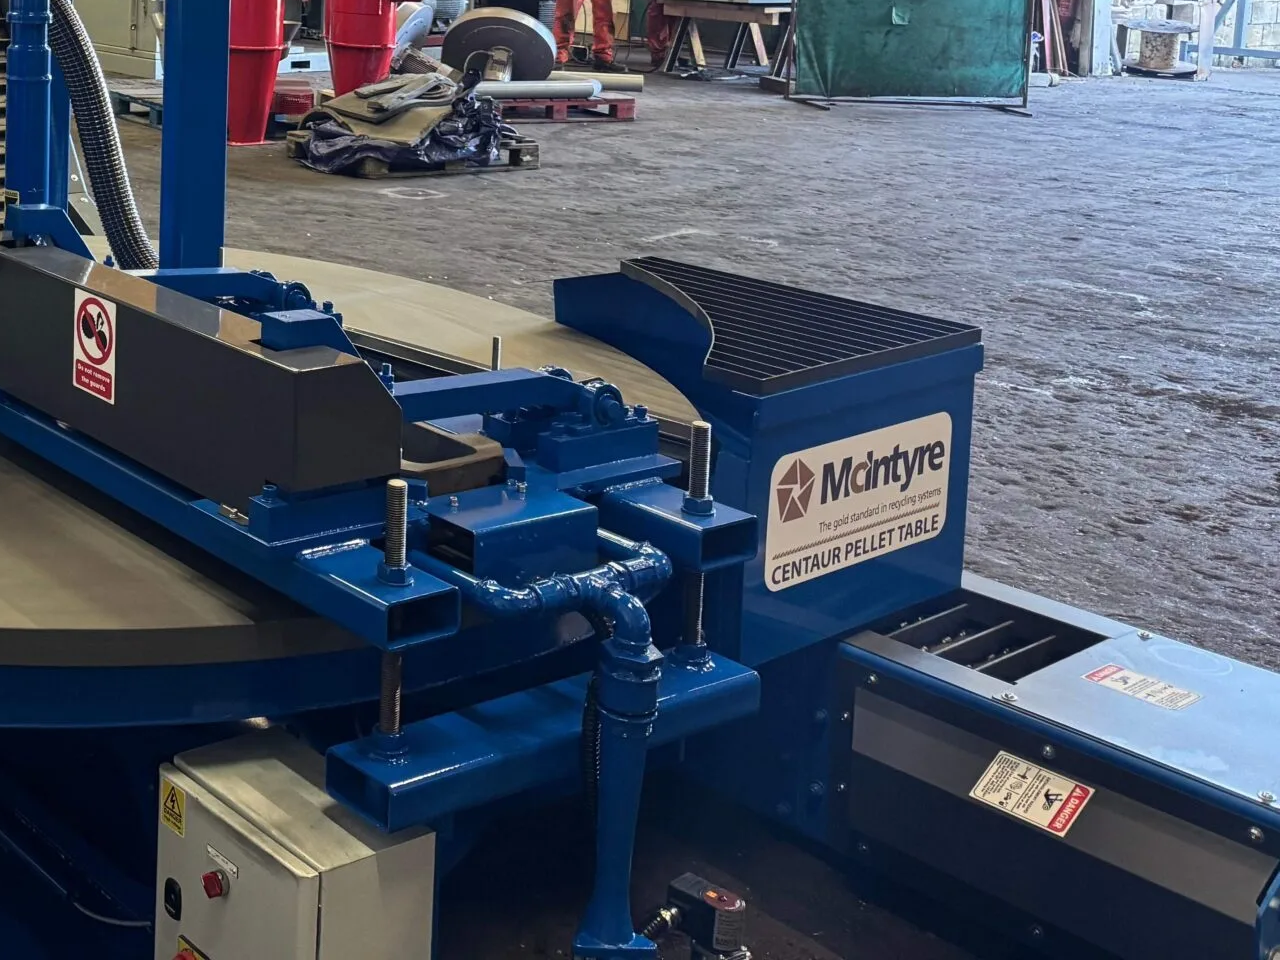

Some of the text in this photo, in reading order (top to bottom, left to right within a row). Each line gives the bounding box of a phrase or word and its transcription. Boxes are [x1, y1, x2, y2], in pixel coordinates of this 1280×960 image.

[84, 367, 93, 375] not
[93, 372, 110, 384] remove
[90, 380, 106, 392] guards
[821, 440, 945, 505] McIntyre
[819, 487, 942, 533] The gold standard in recycling systems
[771, 514, 940, 585] CENTAUR PELLET TABLE
[1051, 797, 1080, 830] DANGER
